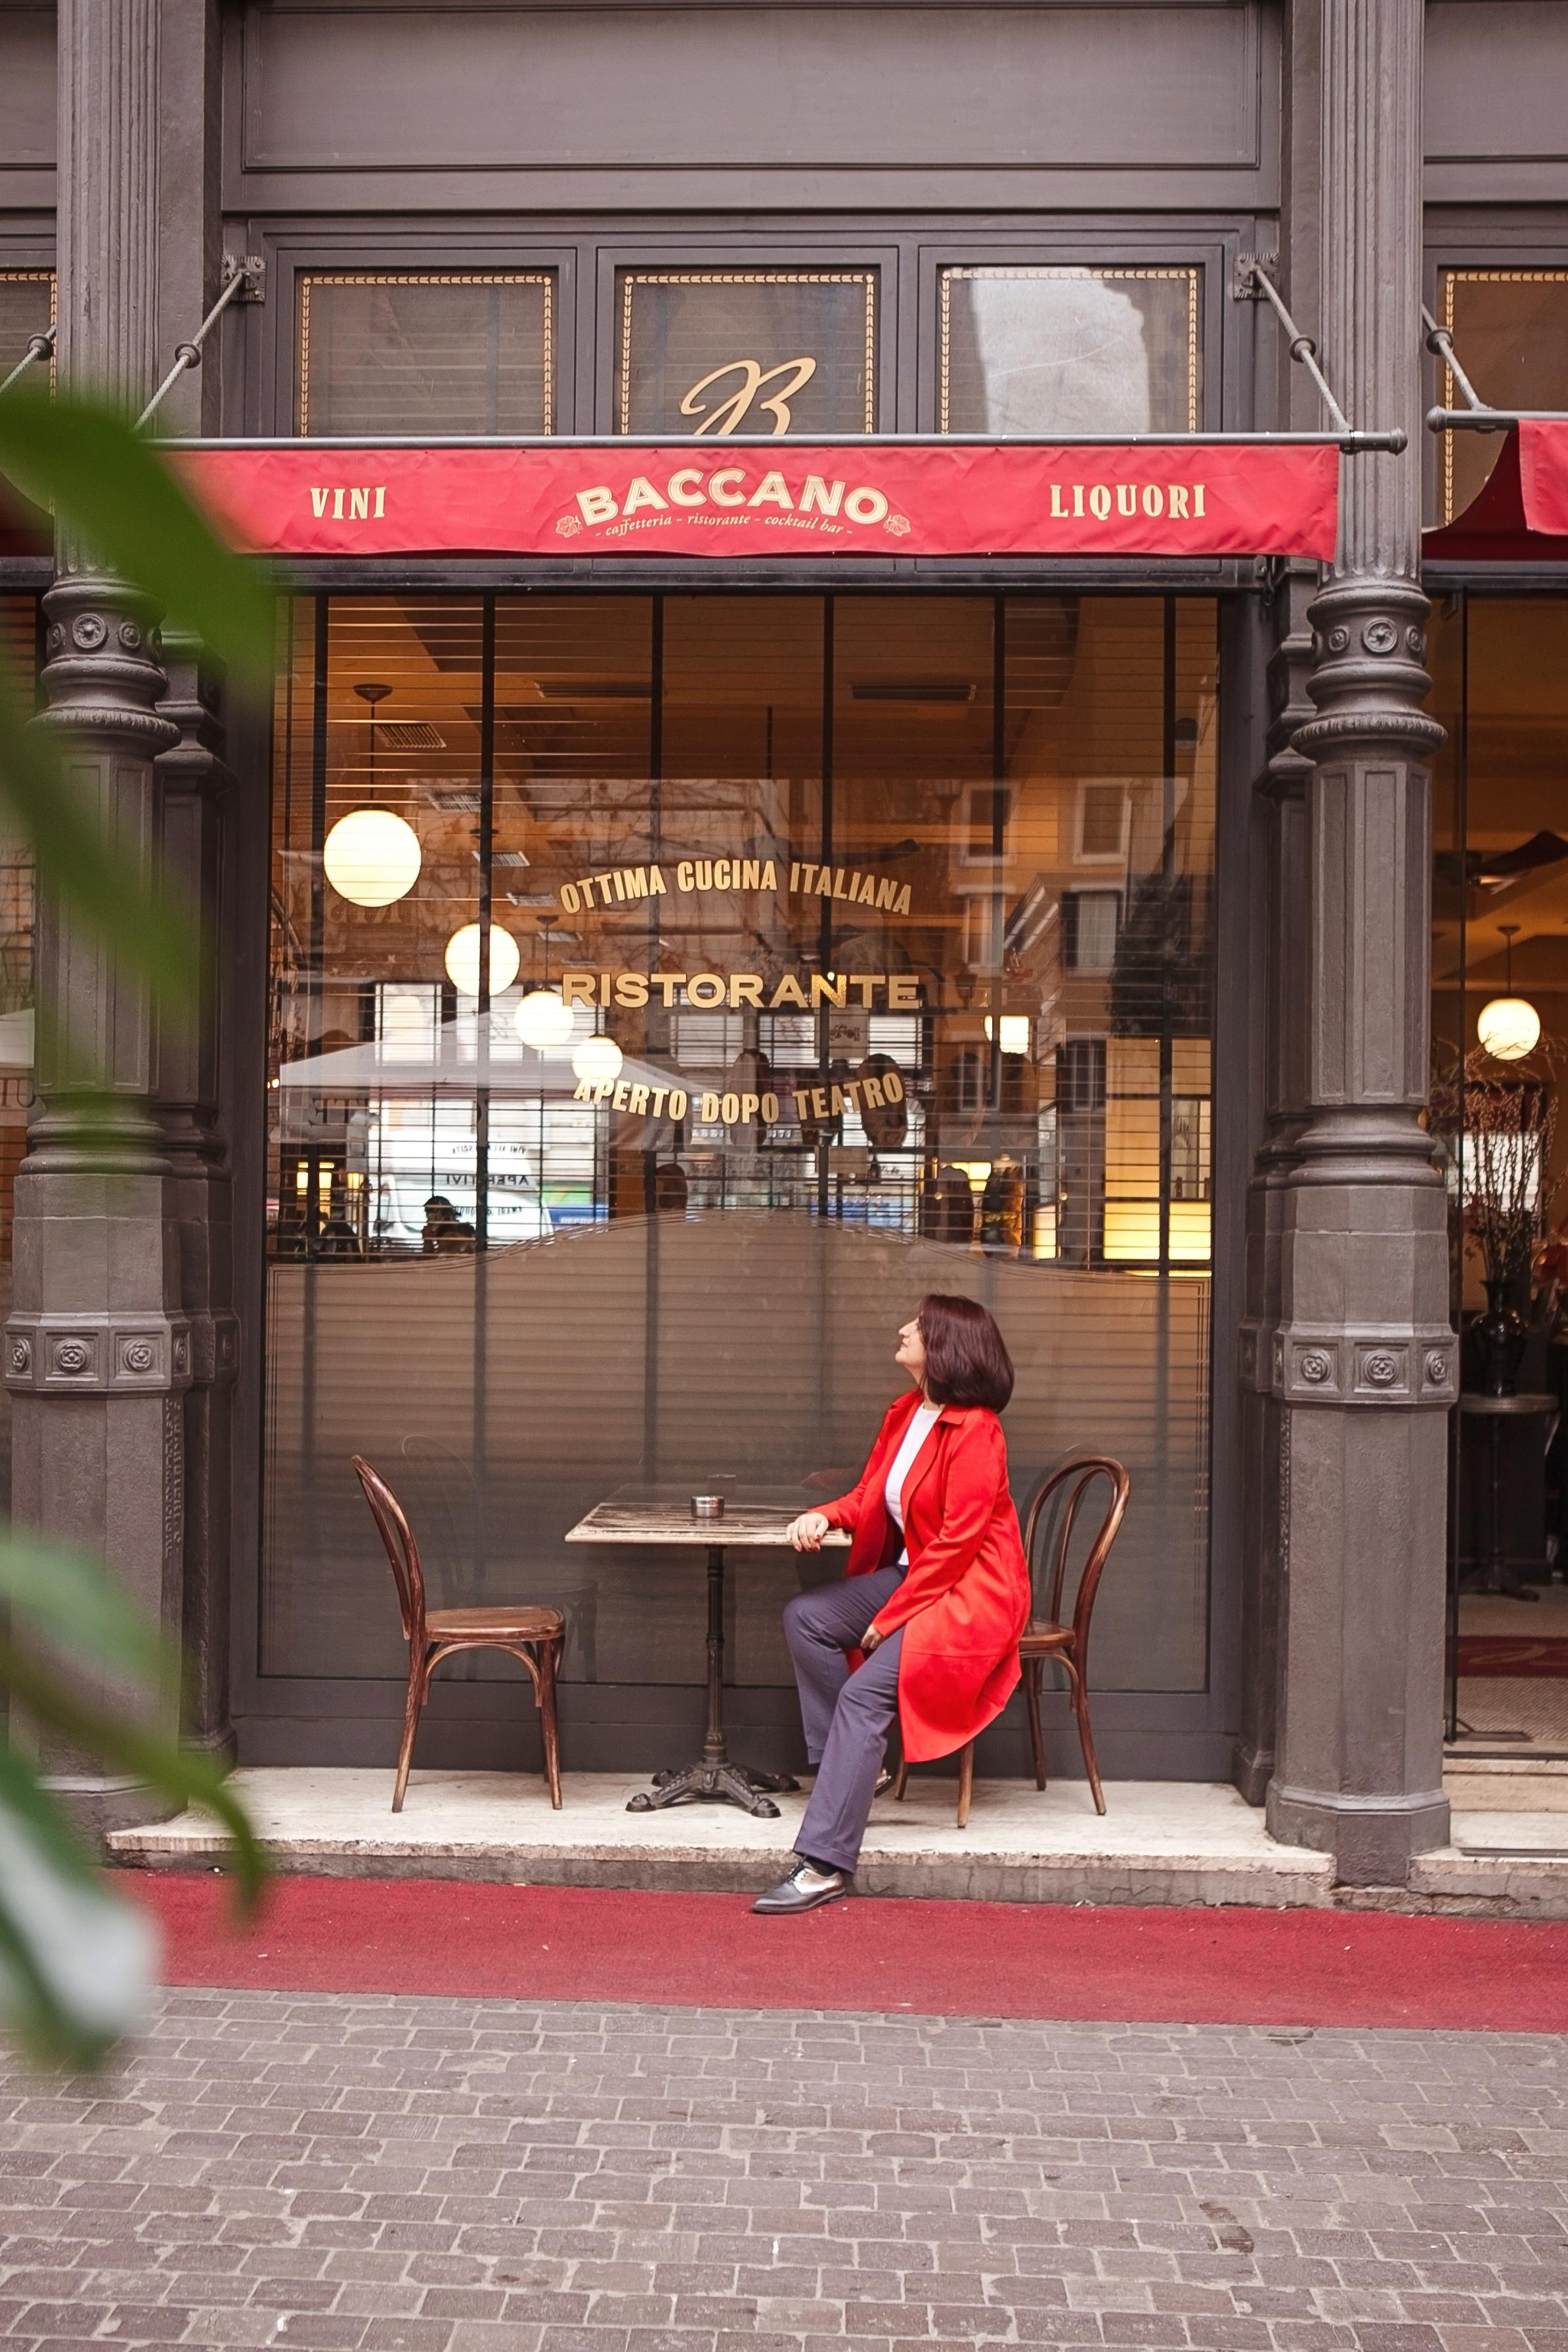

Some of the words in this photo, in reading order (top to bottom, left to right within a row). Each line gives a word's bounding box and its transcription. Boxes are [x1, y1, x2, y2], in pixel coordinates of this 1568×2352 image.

[310, 487, 386, 519] VINI
[575, 468, 888, 526] BACCANO
[1050, 485, 1206, 521] LIQUORI
[605, 514, 672, 536] caffetteria
[687, 513, 750, 526] ristorante
[764, 513, 817, 529] cocktail
[820, 517, 844, 534] bar
[560, 865, 667, 914] OTTIMA
[677, 860, 777, 892] CUCINA
[789, 862, 912, 916] ITALIANA
[562, 972, 920, 1009] RISTORANTE
[573, 1074, 687, 1120] APERTO
[701, 1092, 779, 1124] DOPO
[792, 1072, 904, 1120] TEATRO
